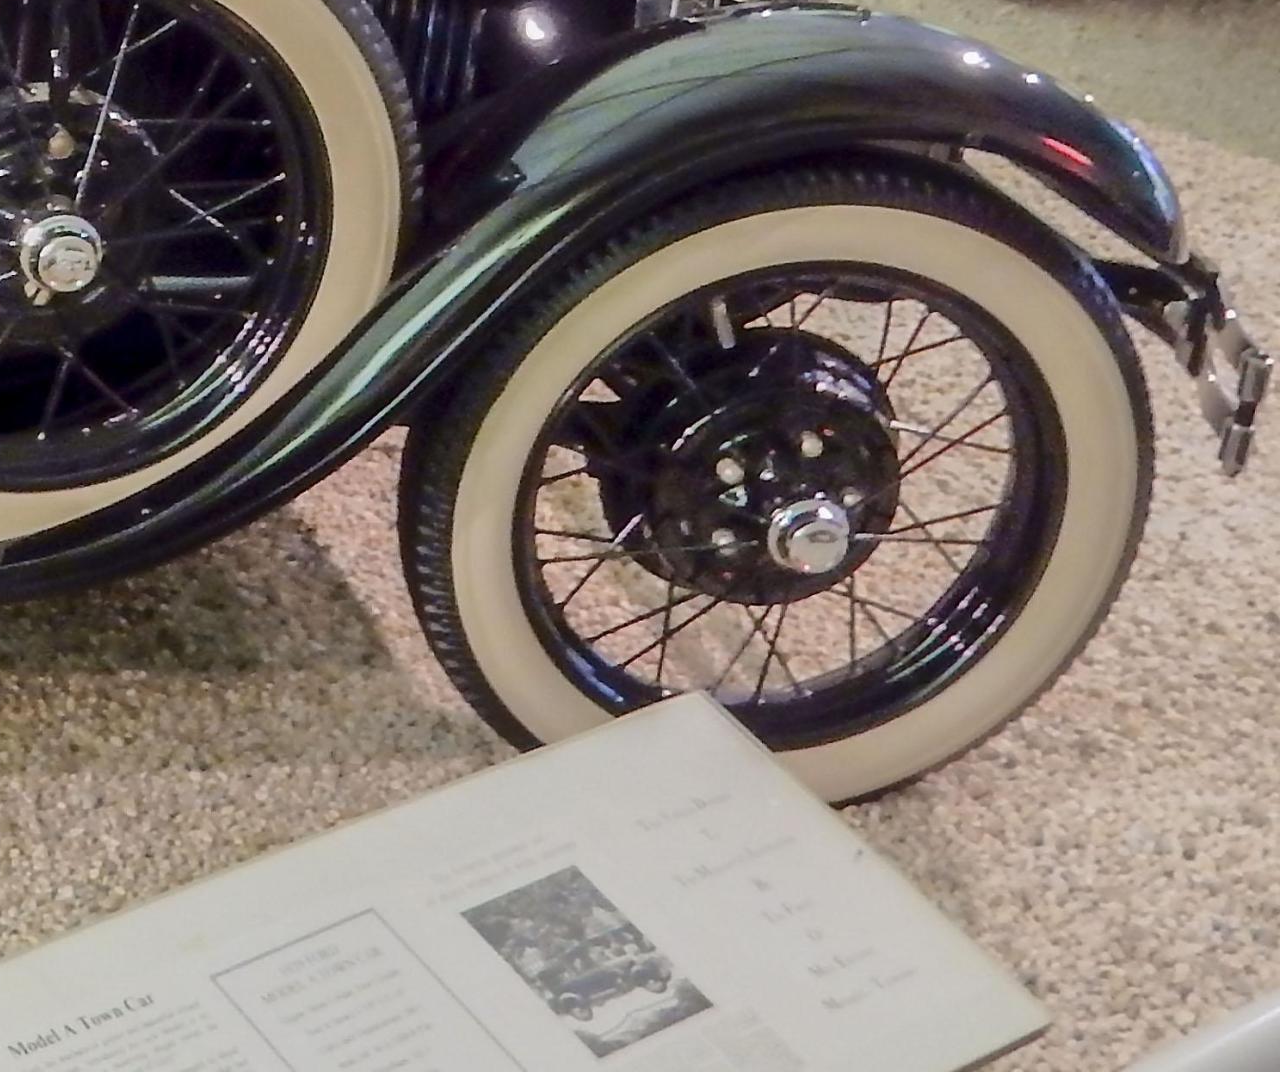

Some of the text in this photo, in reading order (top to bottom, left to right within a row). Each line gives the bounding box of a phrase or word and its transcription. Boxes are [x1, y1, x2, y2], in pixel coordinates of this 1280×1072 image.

[7, 993, 154, 1057] Model A Town Car
